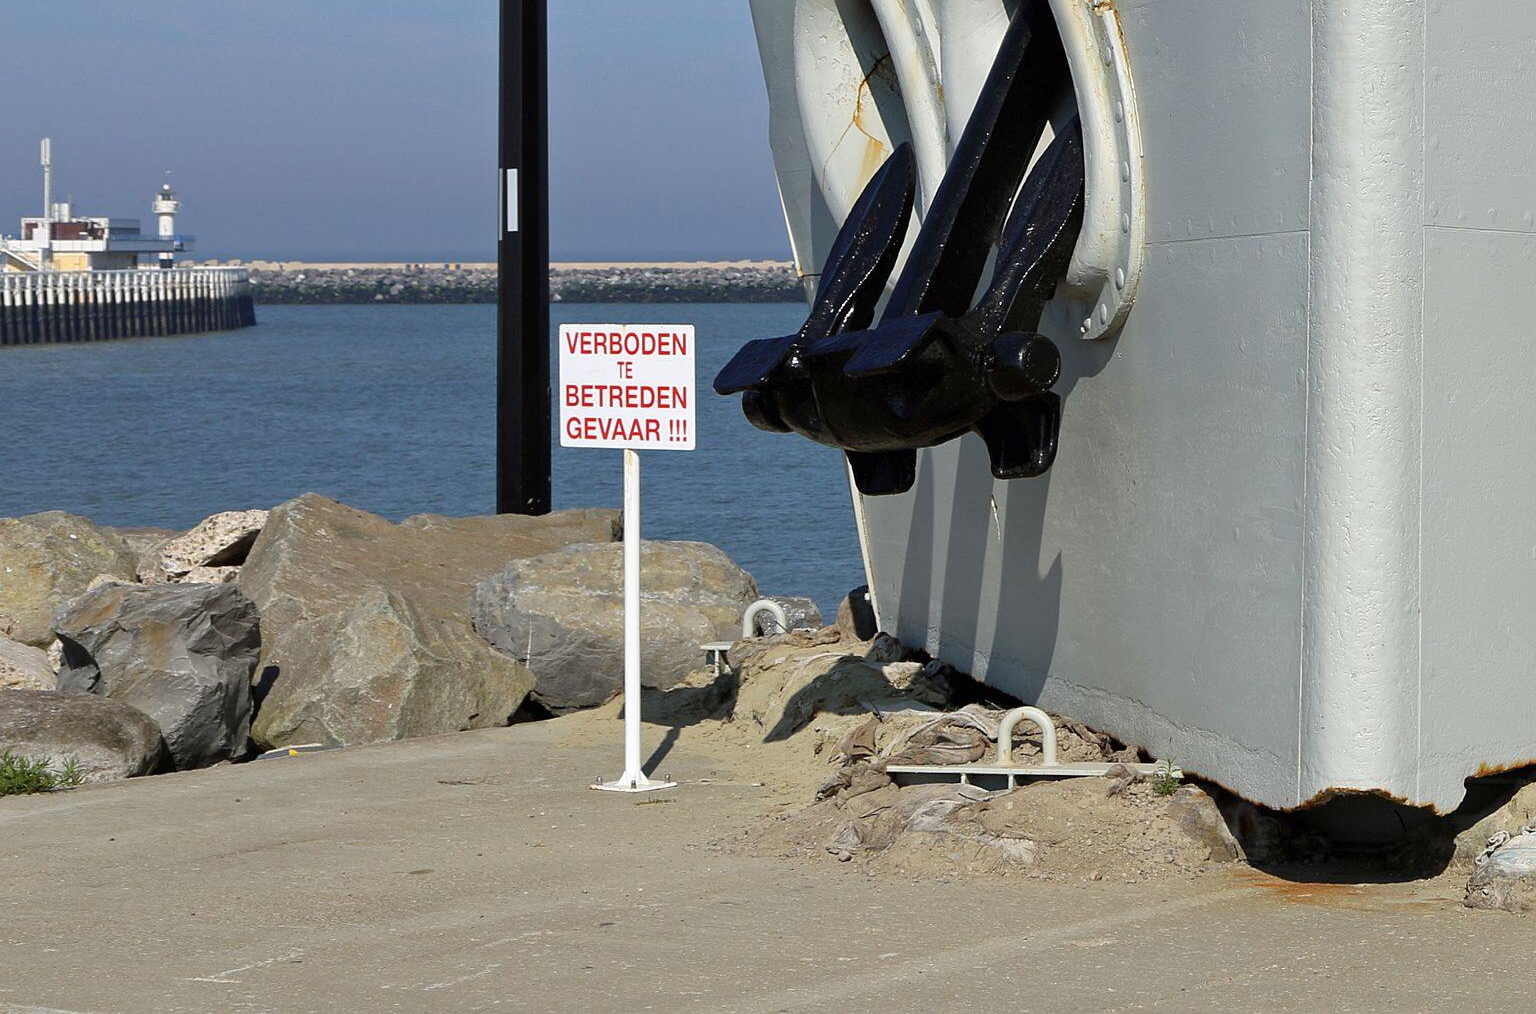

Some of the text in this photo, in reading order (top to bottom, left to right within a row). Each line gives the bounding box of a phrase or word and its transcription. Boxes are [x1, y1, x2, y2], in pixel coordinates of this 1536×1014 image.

[566, 332, 687, 356] VERBODEN
[617, 361, 633, 379] TE
[566, 385, 687, 408] BETREDEN
[566, 417, 661, 441] GEVAAR
